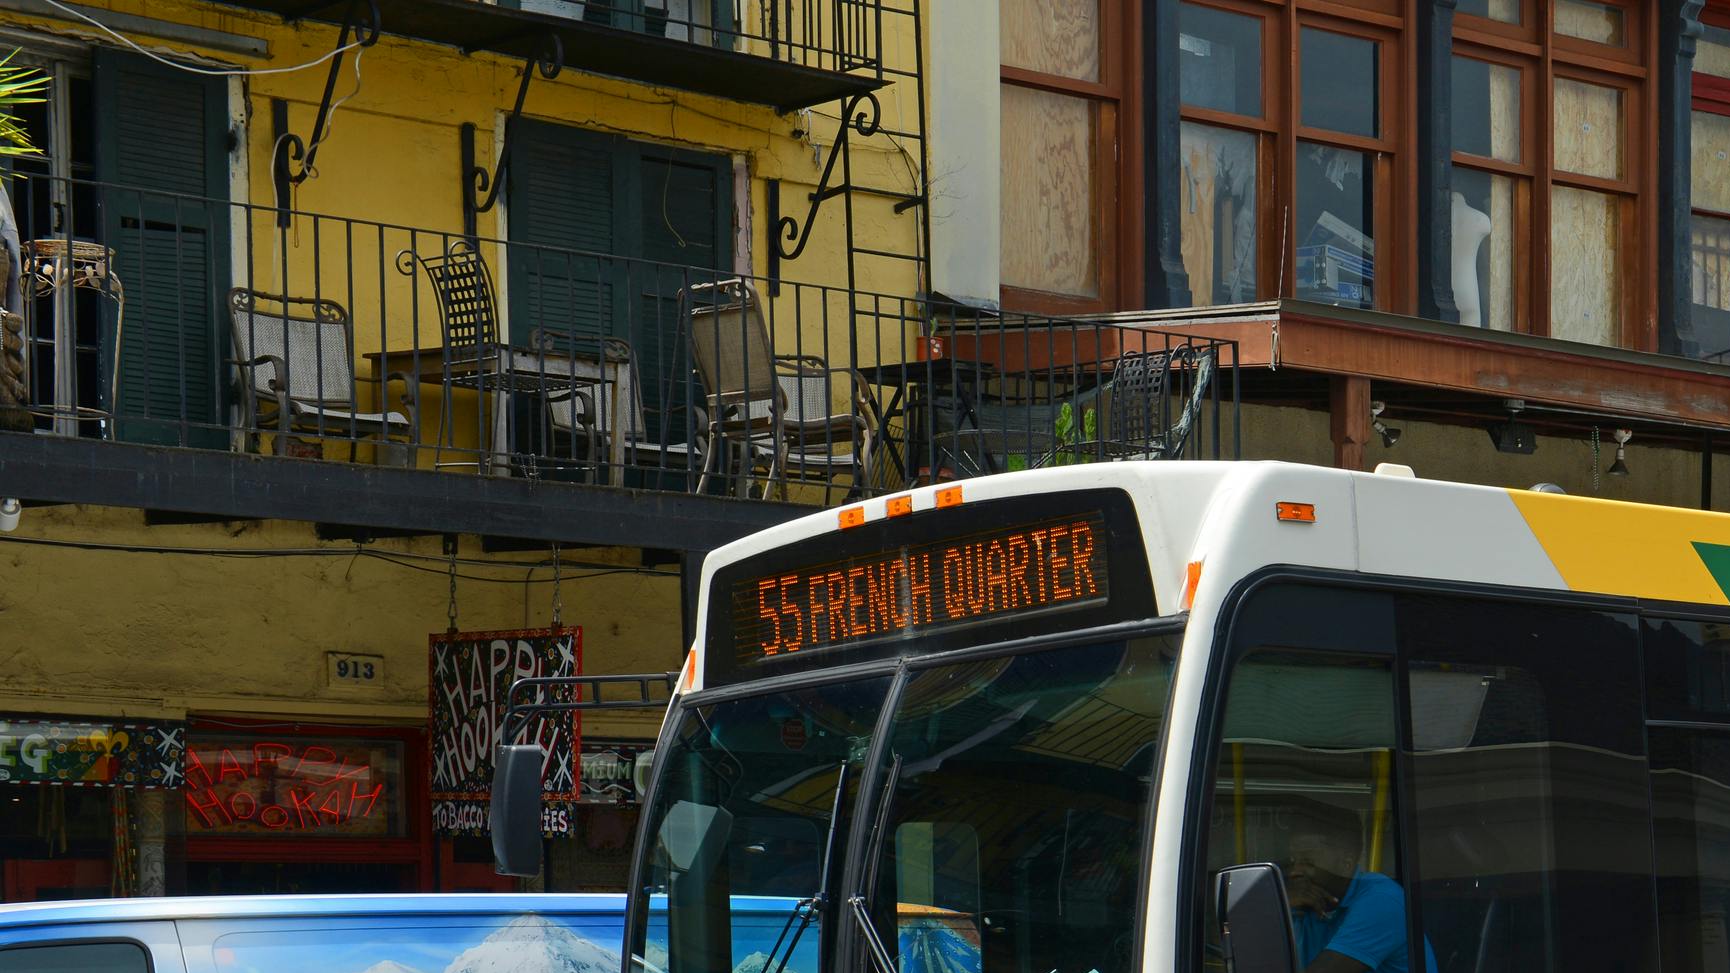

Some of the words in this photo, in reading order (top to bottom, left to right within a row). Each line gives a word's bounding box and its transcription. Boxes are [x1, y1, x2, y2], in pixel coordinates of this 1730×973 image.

[757, 575, 803, 656] 55
[808, 553, 932, 645] FRENCH
[943, 520, 1097, 619] QUARTER
[336, 659, 375, 680] 913
[443, 639, 560, 728] HAPPY
[186, 743, 369, 789] HAPPY
[581, 760, 632, 780] MIUM
[186, 782, 383, 828] HOOKAH
[433, 801, 483, 831] TOBACCO
